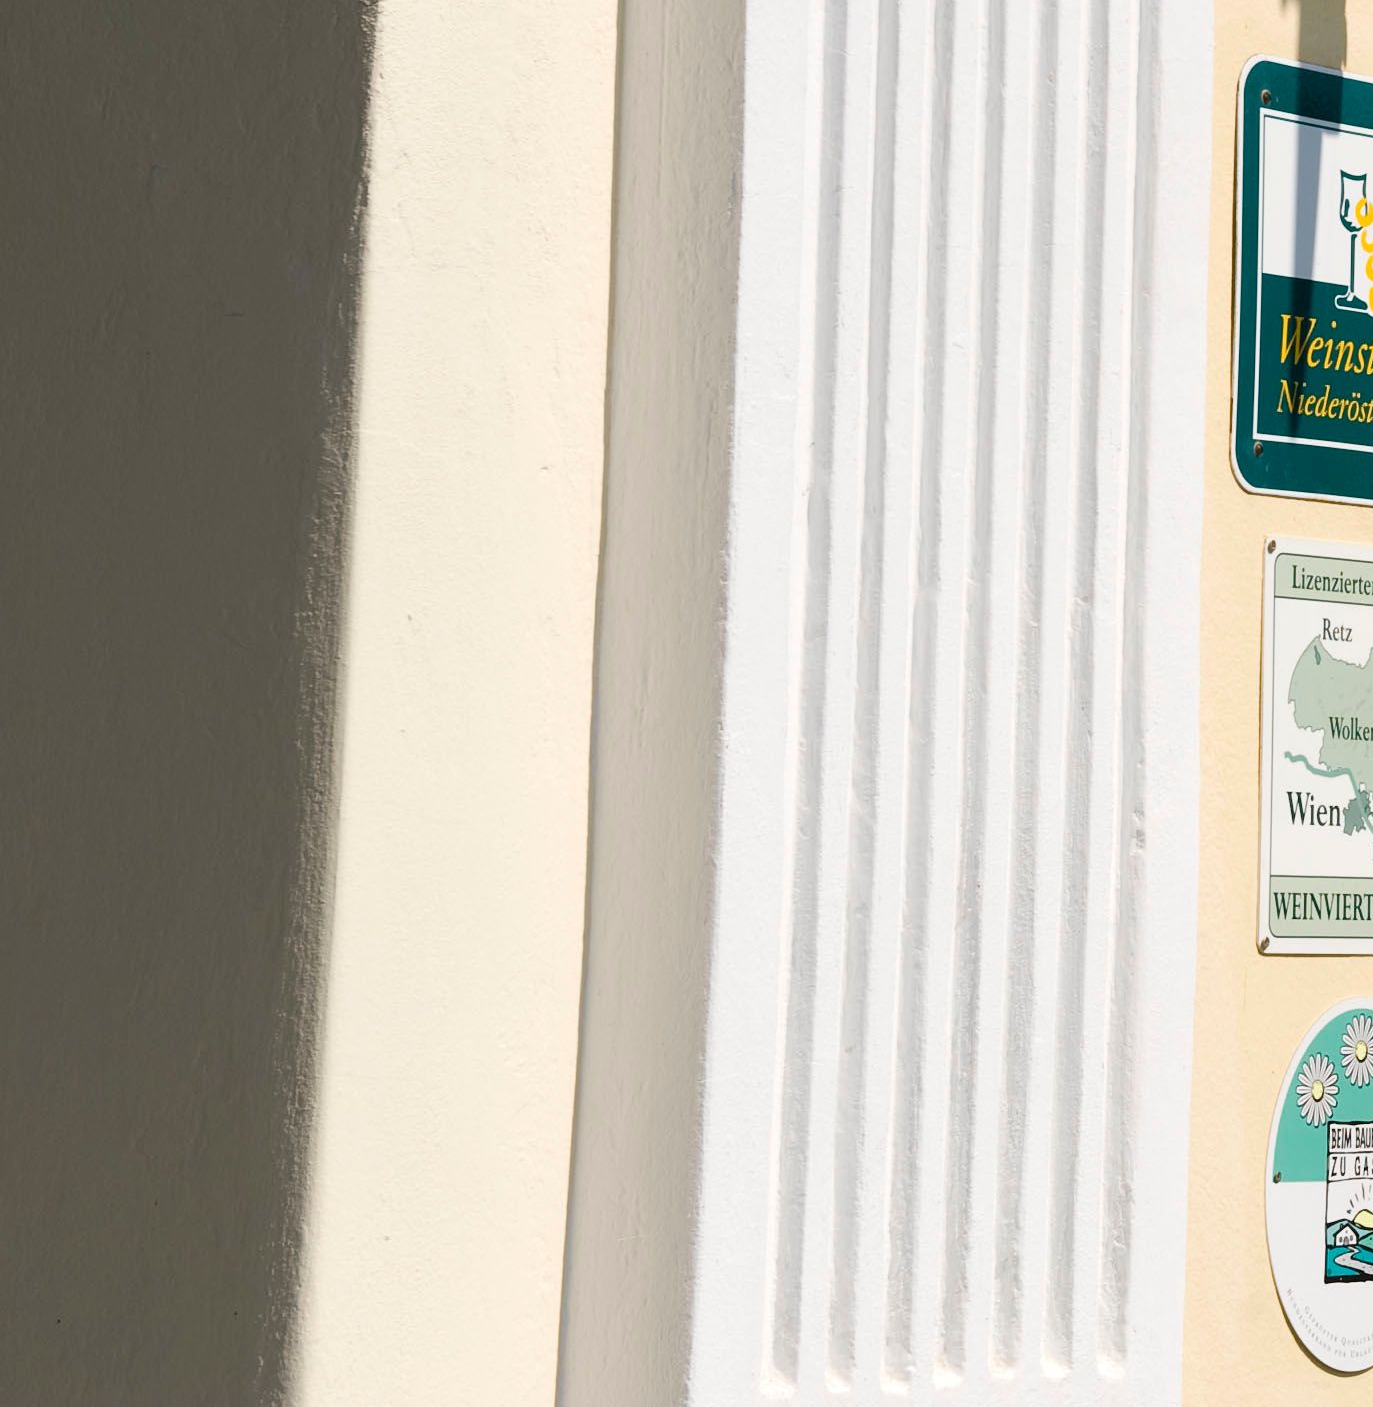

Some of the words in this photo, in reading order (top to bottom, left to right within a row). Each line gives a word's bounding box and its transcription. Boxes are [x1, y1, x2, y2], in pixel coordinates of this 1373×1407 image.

[1322, 618, 1353, 643] Retz
[1286, 791, 1341, 827] Wien
[1331, 1127, 1352, 1149] BEIM
[1331, 1156, 1346, 1177] ZU
